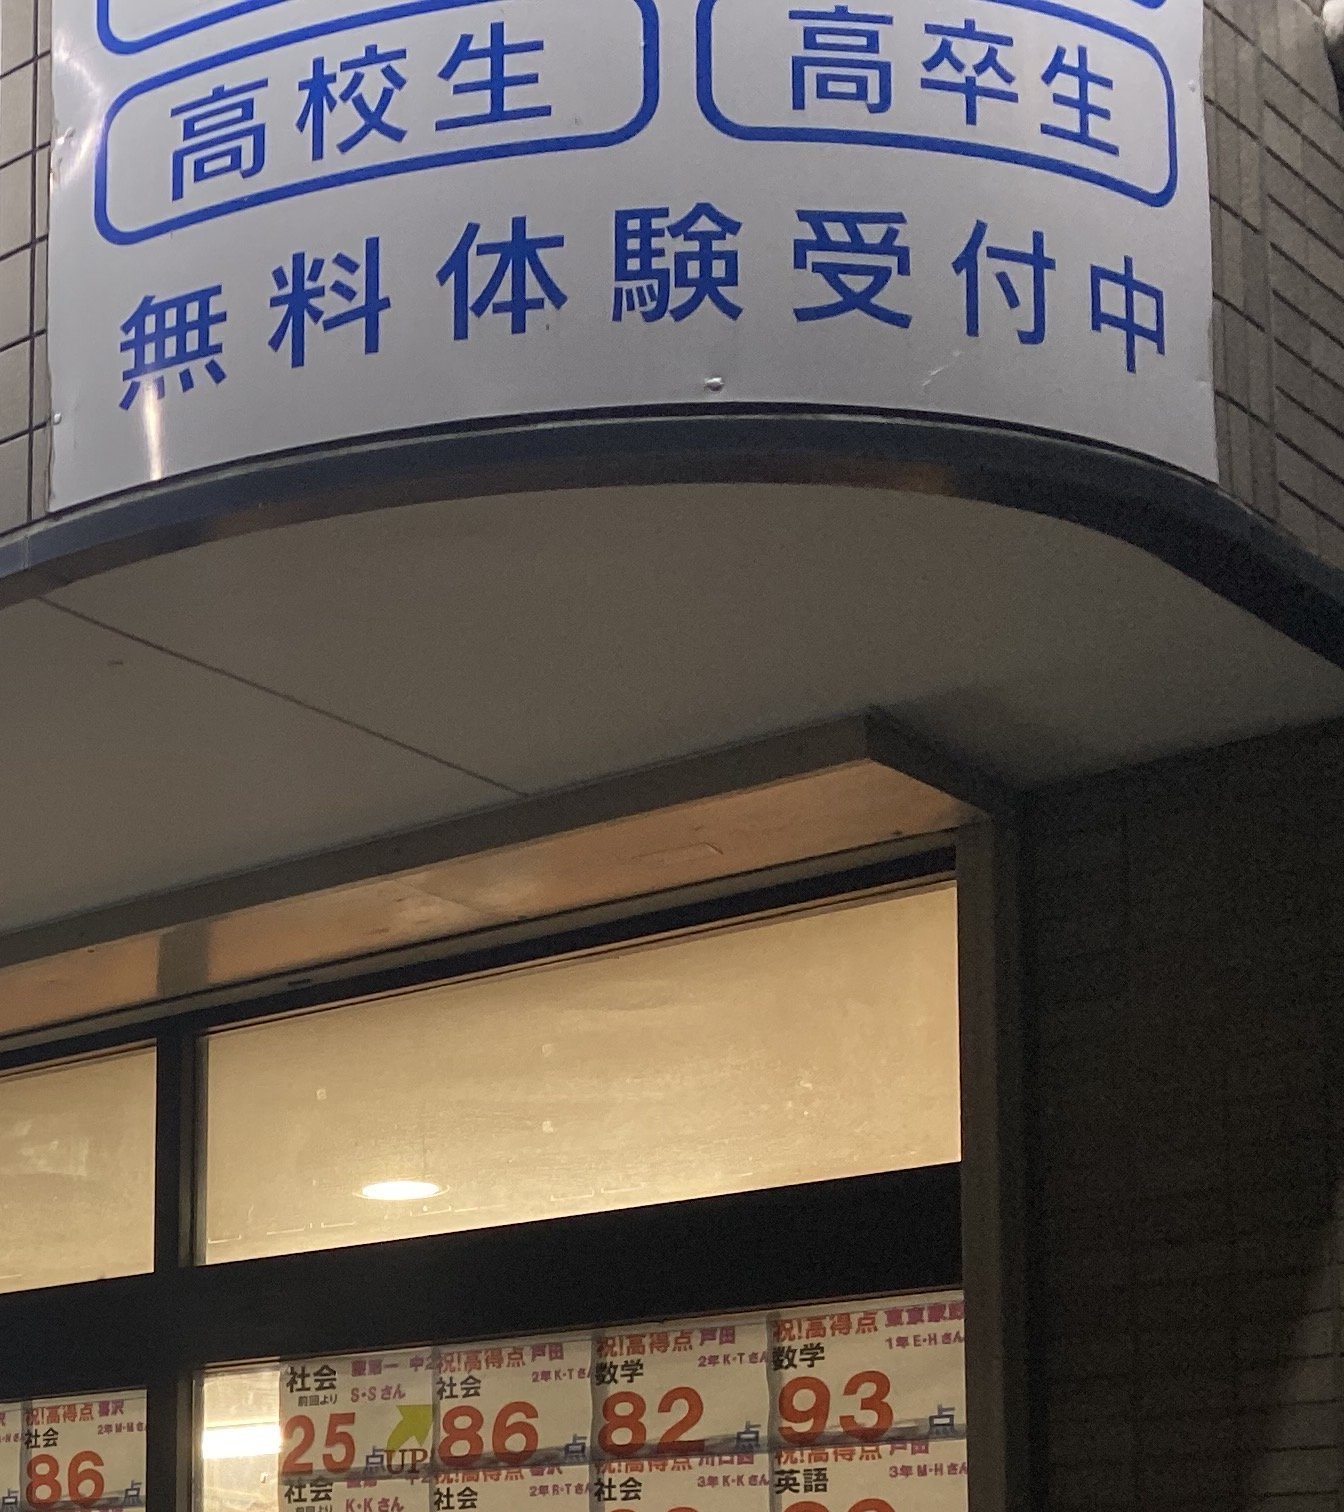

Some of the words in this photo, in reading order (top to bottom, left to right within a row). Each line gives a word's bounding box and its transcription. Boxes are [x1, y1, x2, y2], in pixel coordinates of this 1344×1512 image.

[789, 4, 1121, 158] 高卒生
[168, 20, 554, 202] 高校生
[117, 202, 1167, 411] 無料体験受付中
[595, 1359, 644, 1386] 数学
[773, 1343, 825, 1371] 数学
[287, 1365, 337, 1393] 社会
[436, 1375, 481, 1400] 社会
[598, 1386, 705, 1455] 82
[777, 1370, 894, 1446] 93
[24, 1427, 59, 1449] 社会
[282, 1411, 356, 1474] 25
[438, 1401, 539, 1468] 86
[26, 1450, 104, 1509] 86
[434, 1487, 478, 1511] 社会
[594, 1477, 642, 1502] 社会
[774, 1467, 829, 1494] 英語
